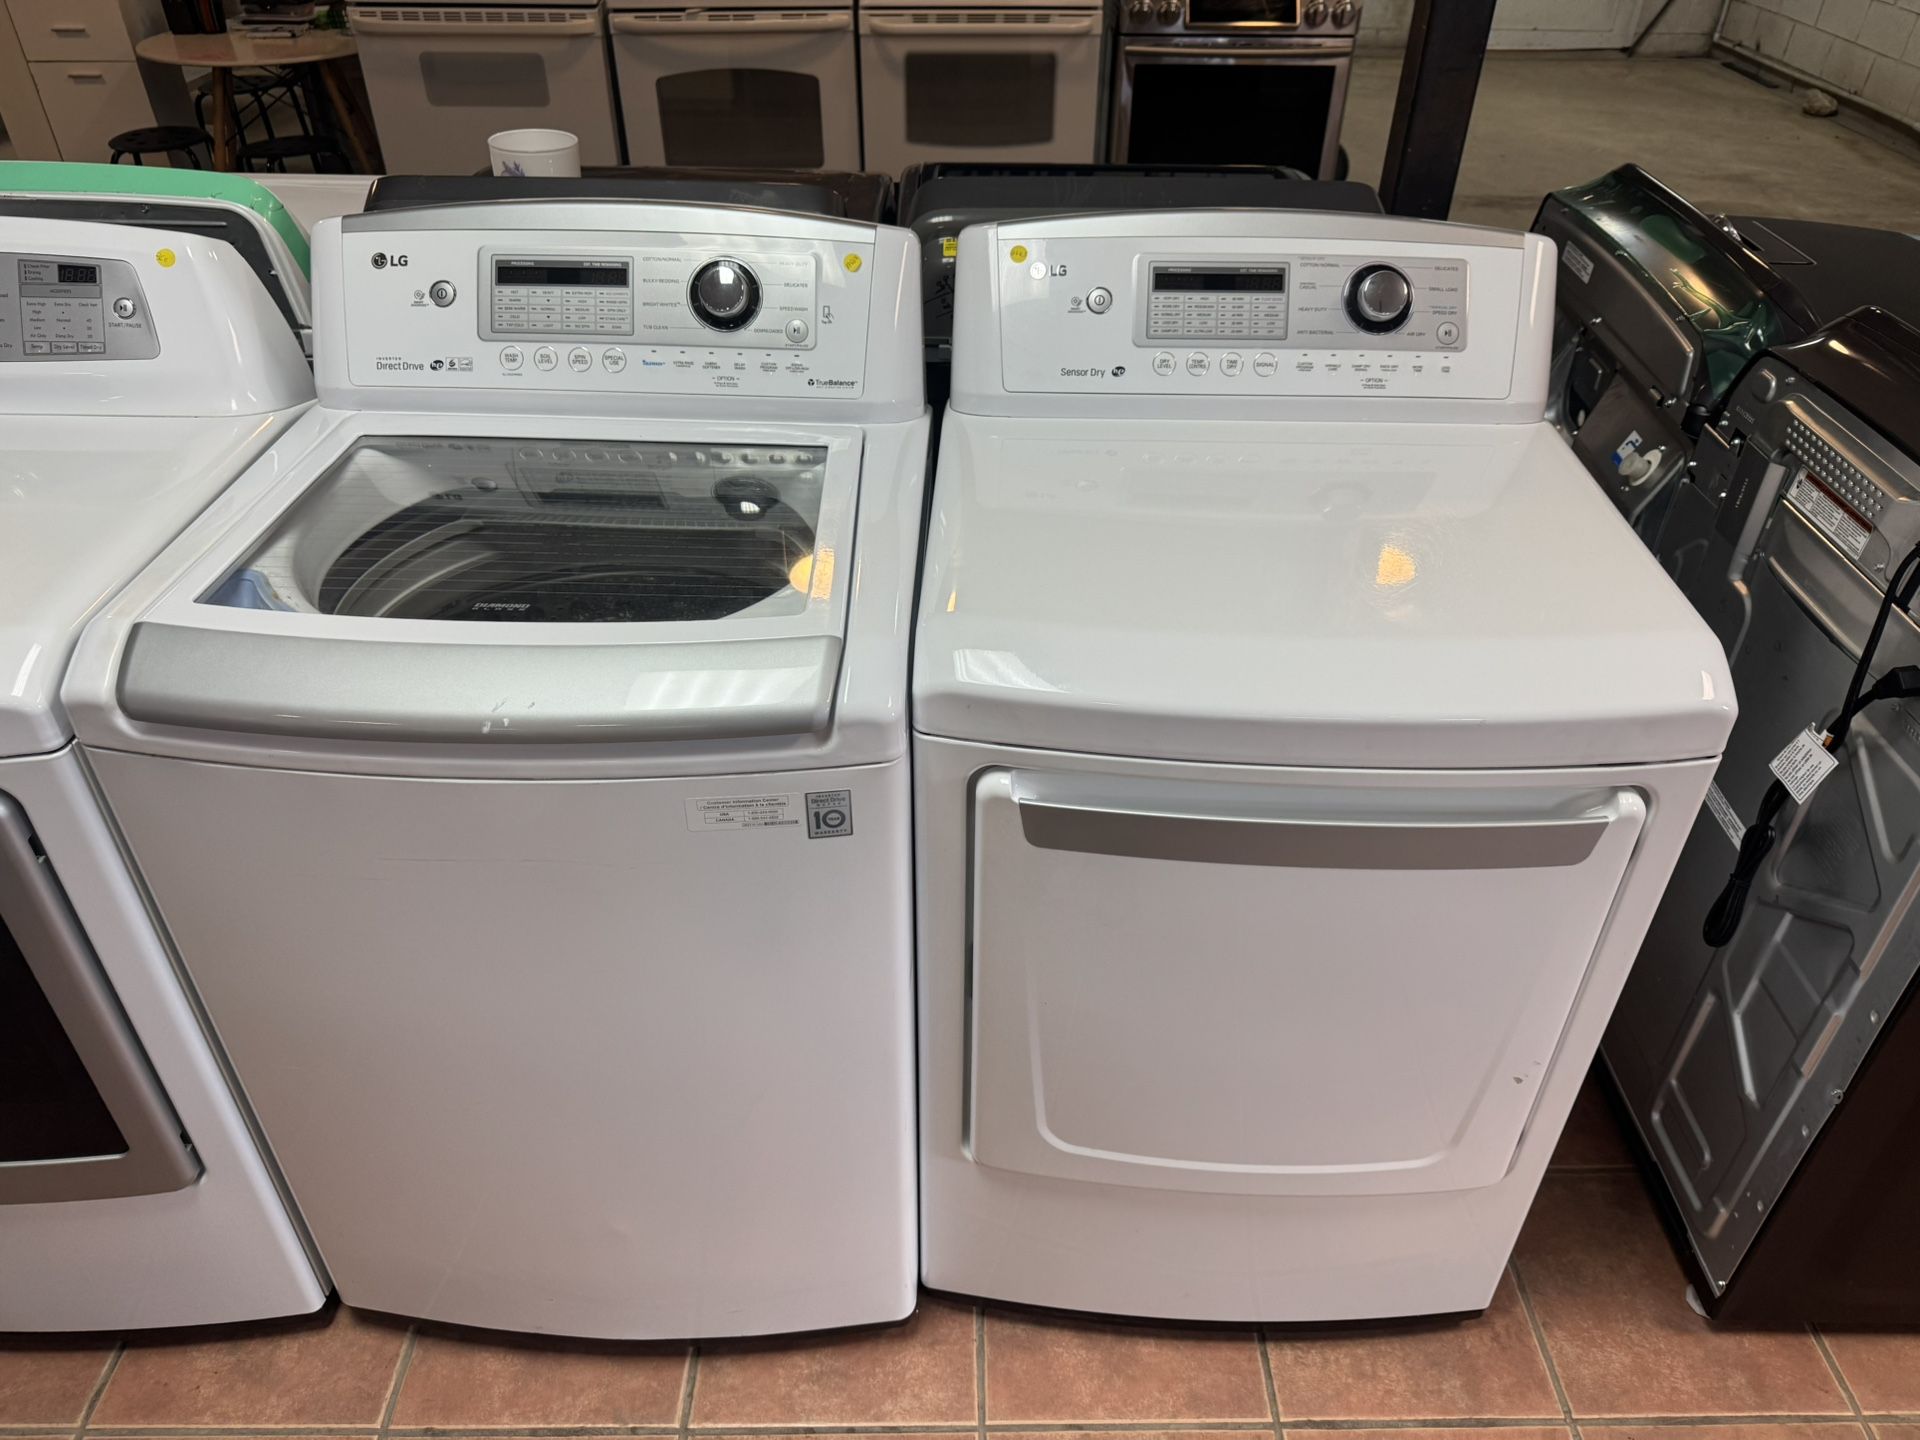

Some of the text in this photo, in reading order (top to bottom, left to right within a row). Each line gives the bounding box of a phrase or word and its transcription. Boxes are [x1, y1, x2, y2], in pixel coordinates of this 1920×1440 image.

[390, 255, 408, 267] LG
[1050, 264, 1067, 277] LG
[108, 321, 142, 329] START/PAUSE
[376, 361, 424, 371] Direct Drive
[1060, 367, 1105, 379] Sensor Dry
[814, 809, 846, 830] 10
